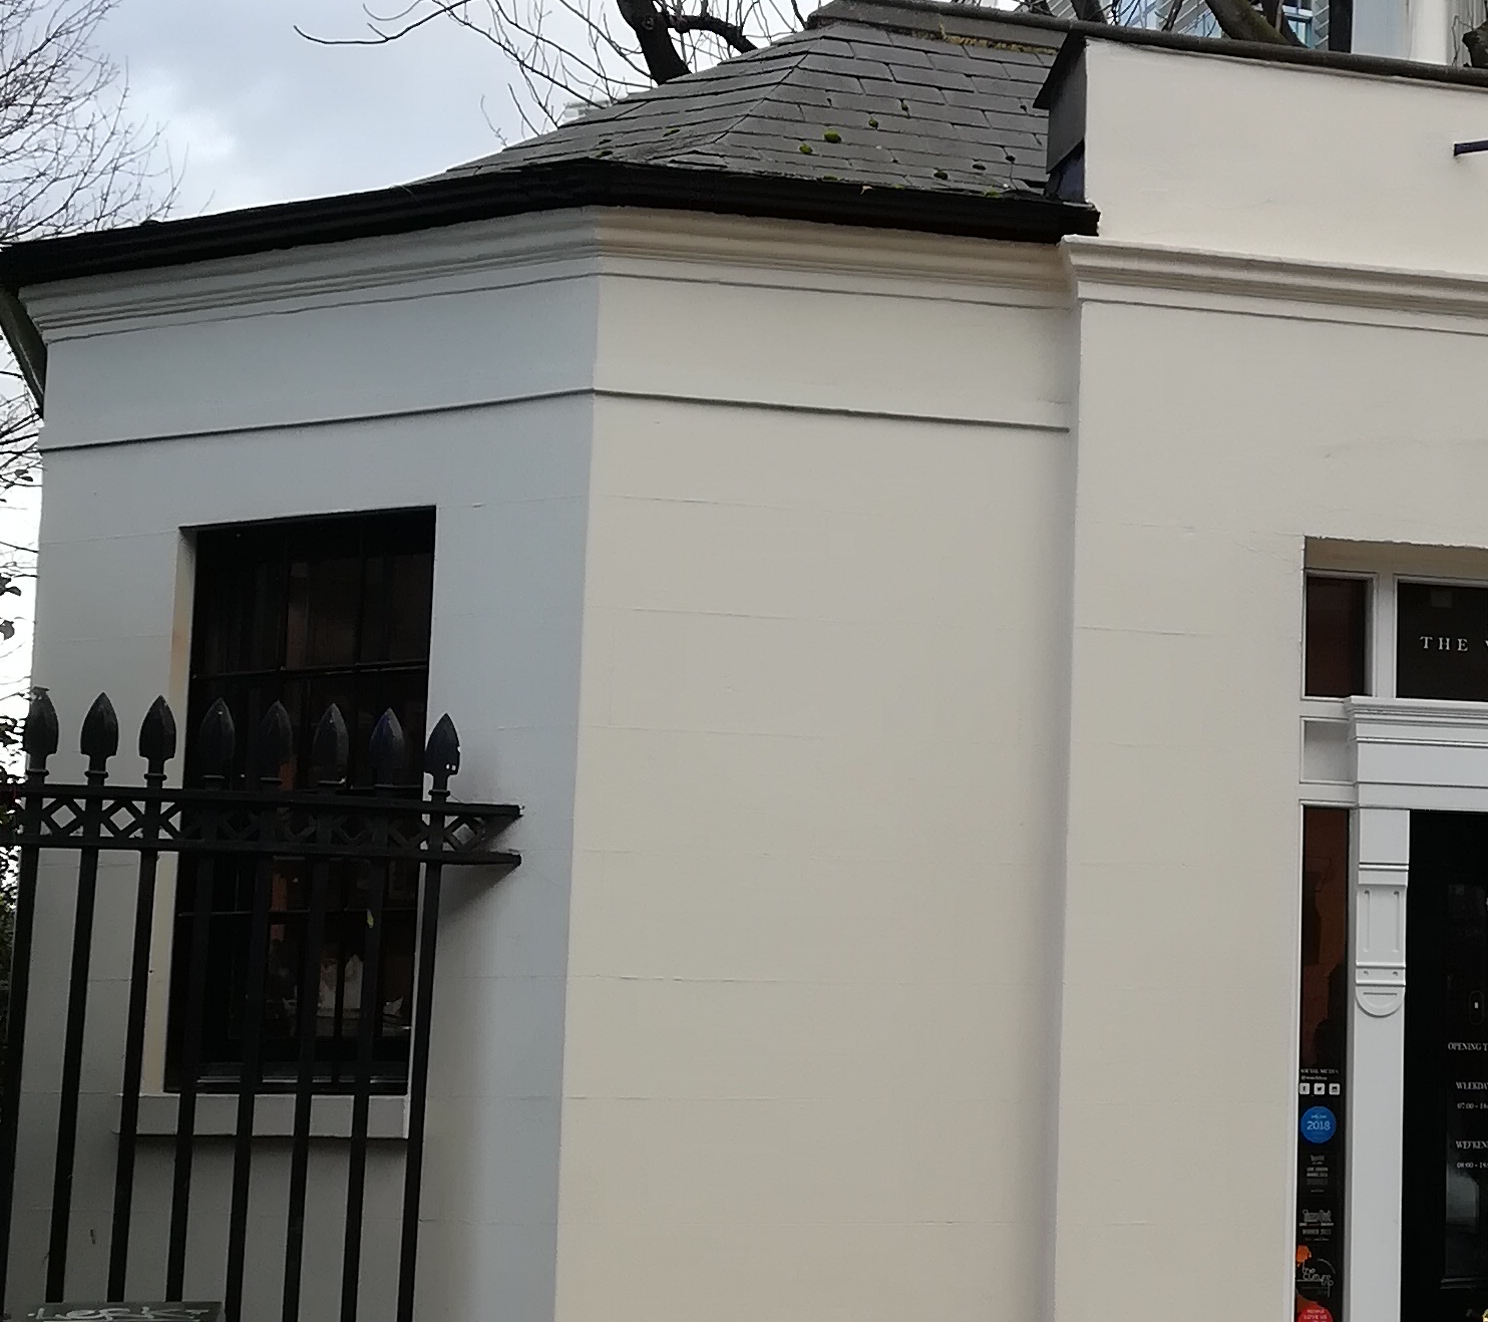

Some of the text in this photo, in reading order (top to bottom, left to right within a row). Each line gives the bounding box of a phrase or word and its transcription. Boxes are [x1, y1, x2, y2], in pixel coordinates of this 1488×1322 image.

[1420, 636, 1469, 652] THE
[1447, 1041, 1482, 1051] OPENING
[1306, 1120, 1331, 1131] 2018
